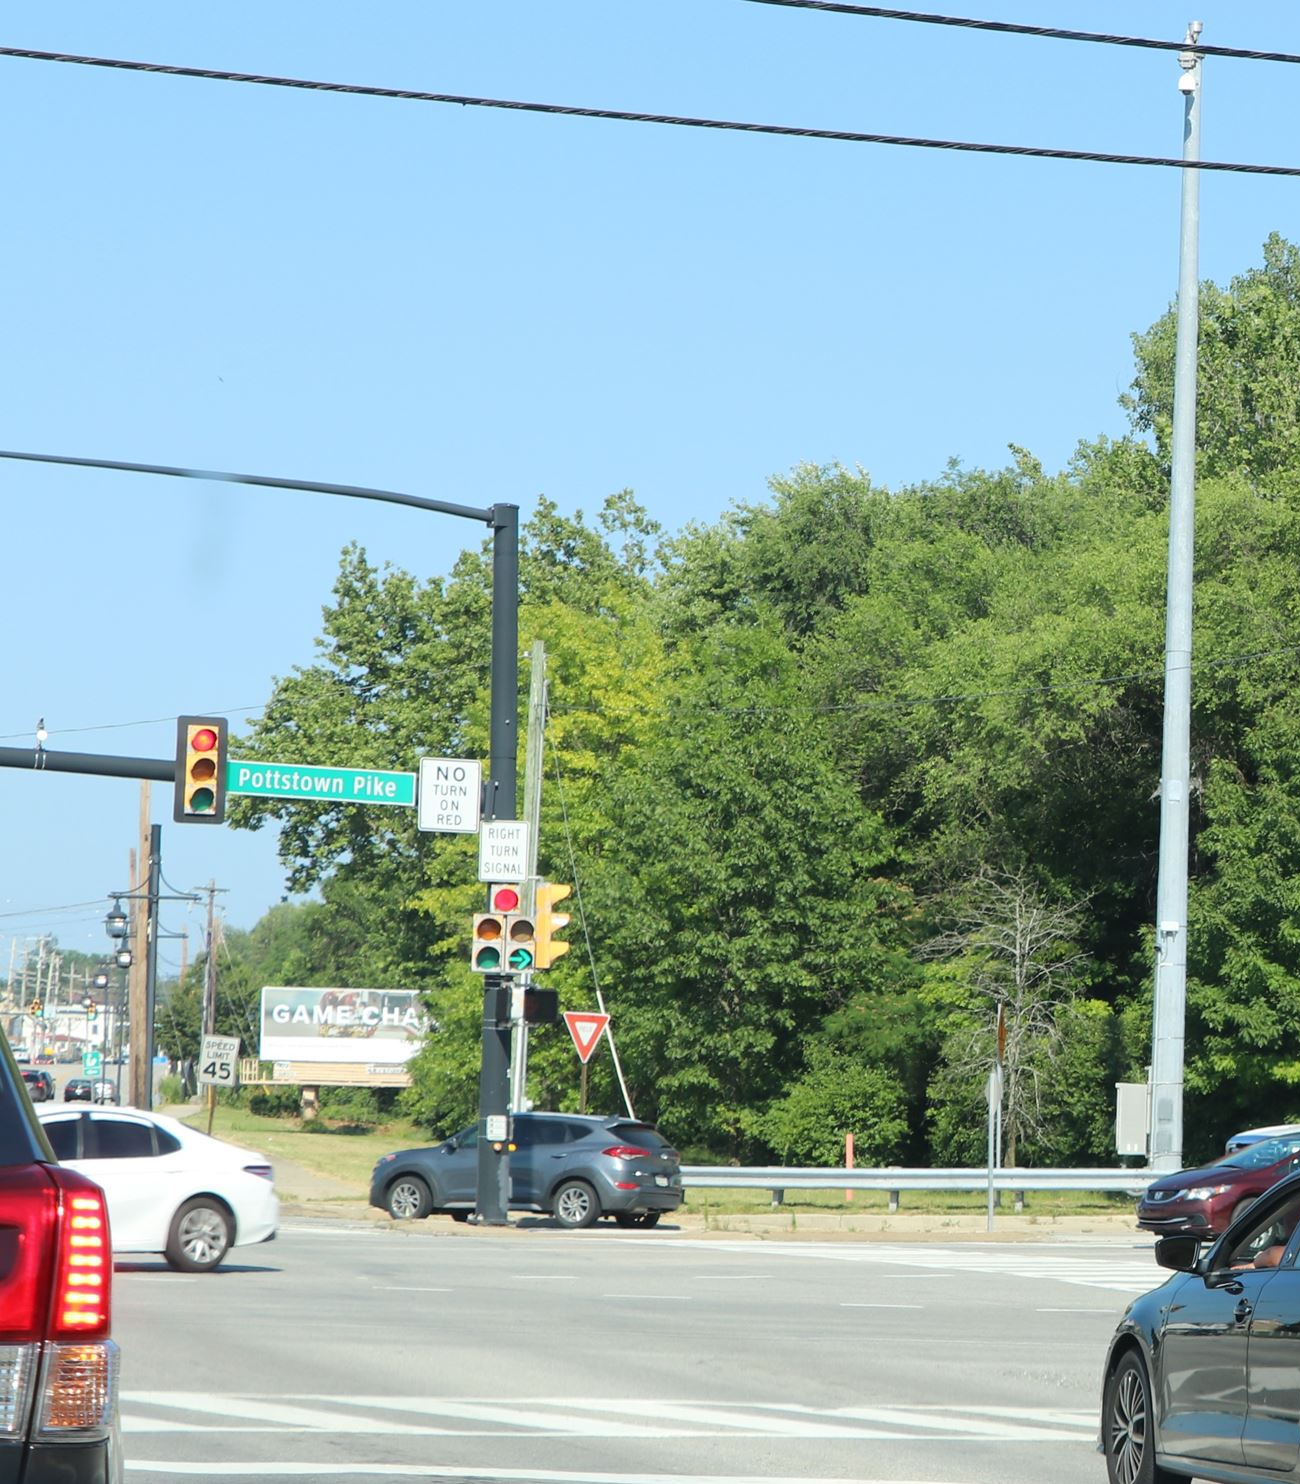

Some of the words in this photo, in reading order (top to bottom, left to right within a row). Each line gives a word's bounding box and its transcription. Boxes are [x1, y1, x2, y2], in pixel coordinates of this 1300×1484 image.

[436, 766, 466, 782] NO
[238, 768, 343, 794] Pottstown
[353, 775, 397, 798] Pike
[434, 784, 467, 797] TURN
[440, 799, 460, 811] ON
[437, 813, 462, 826] RED
[488, 827, 520, 840] RIGHT
[490, 845, 518, 857] TURN
[483, 861, 523, 875] SIGNAL
[272, 1004, 350, 1026] GAME
[205, 1040, 236, 1051] SPEED
[206, 1051, 230, 1061] LIMIT
[203, 1061, 231, 1080] 45
